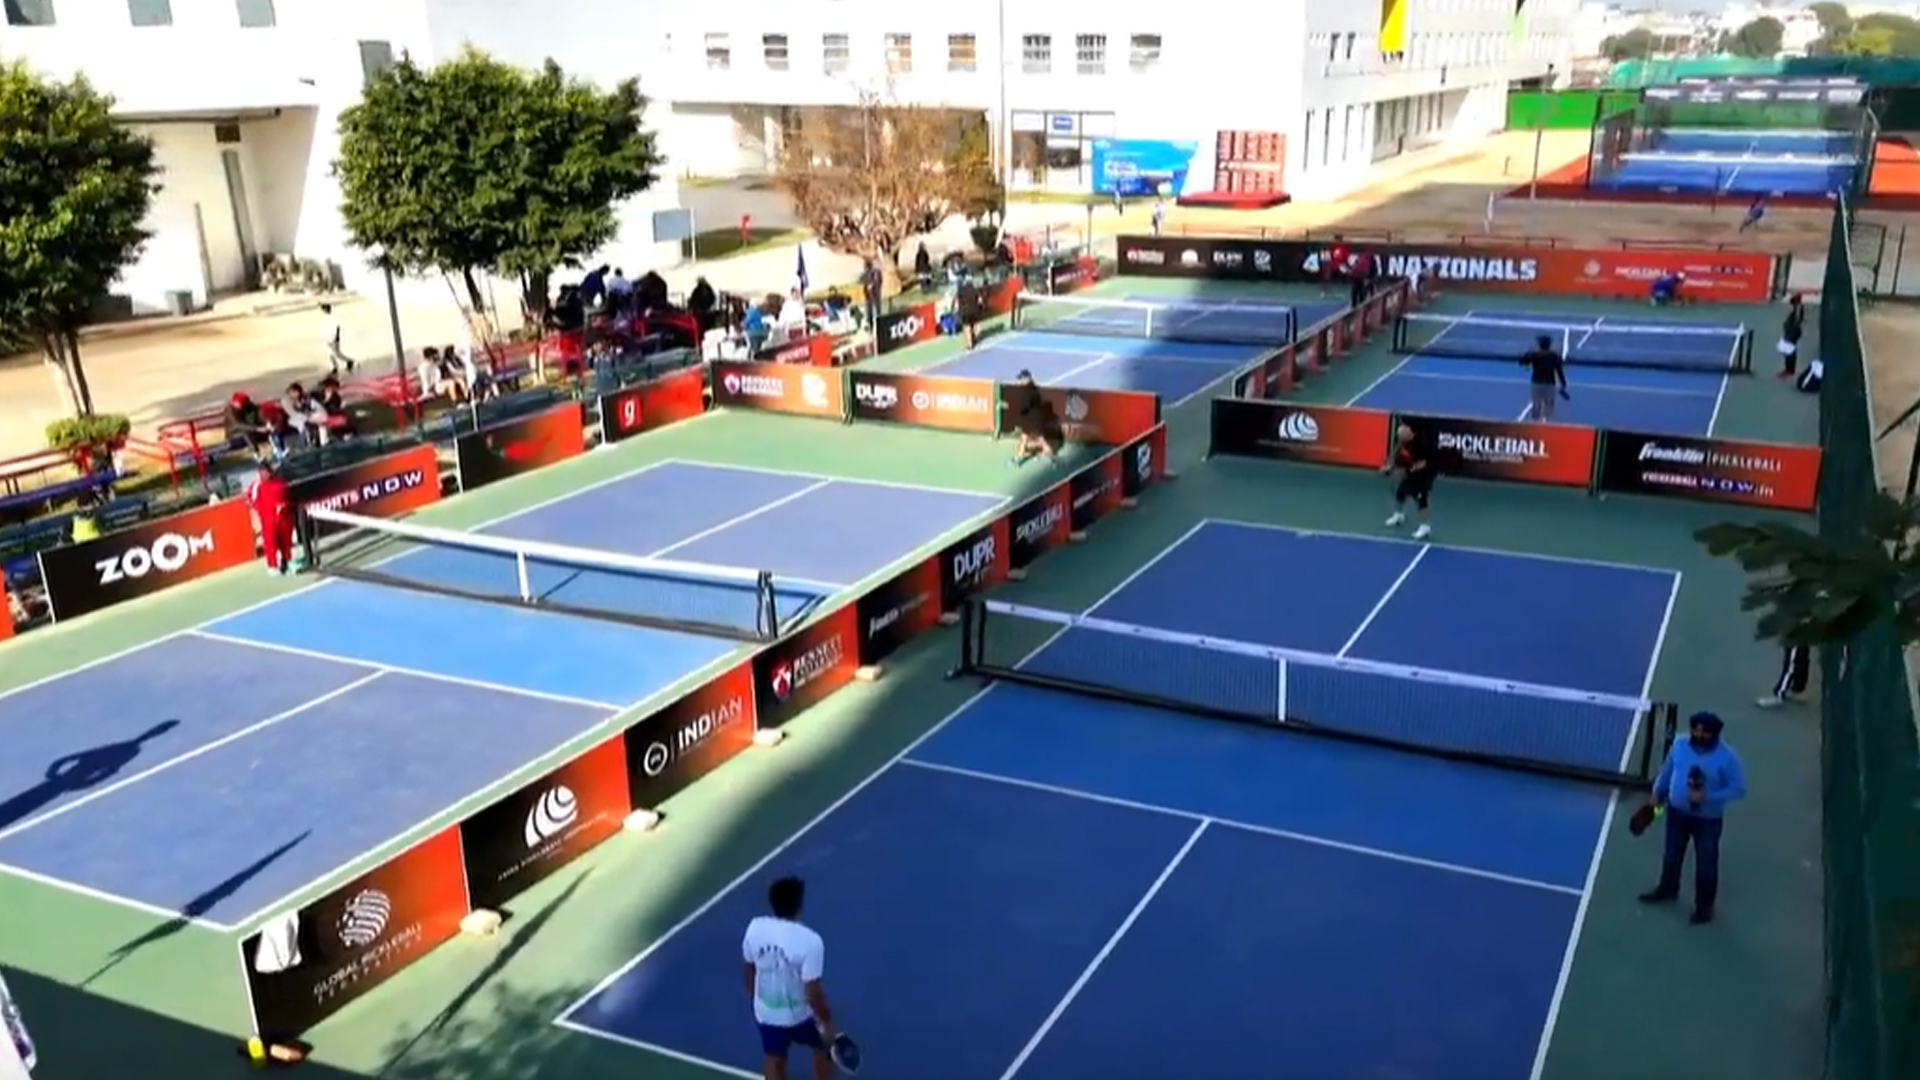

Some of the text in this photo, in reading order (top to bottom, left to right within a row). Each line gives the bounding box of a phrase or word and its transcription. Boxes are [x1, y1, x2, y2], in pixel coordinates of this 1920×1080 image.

[1388, 254, 1537, 281] NATIONALS
[95, 529, 214, 585] ZOOM
[954, 536, 995, 583] DUPR
[678, 696, 742, 750] INDIAN
